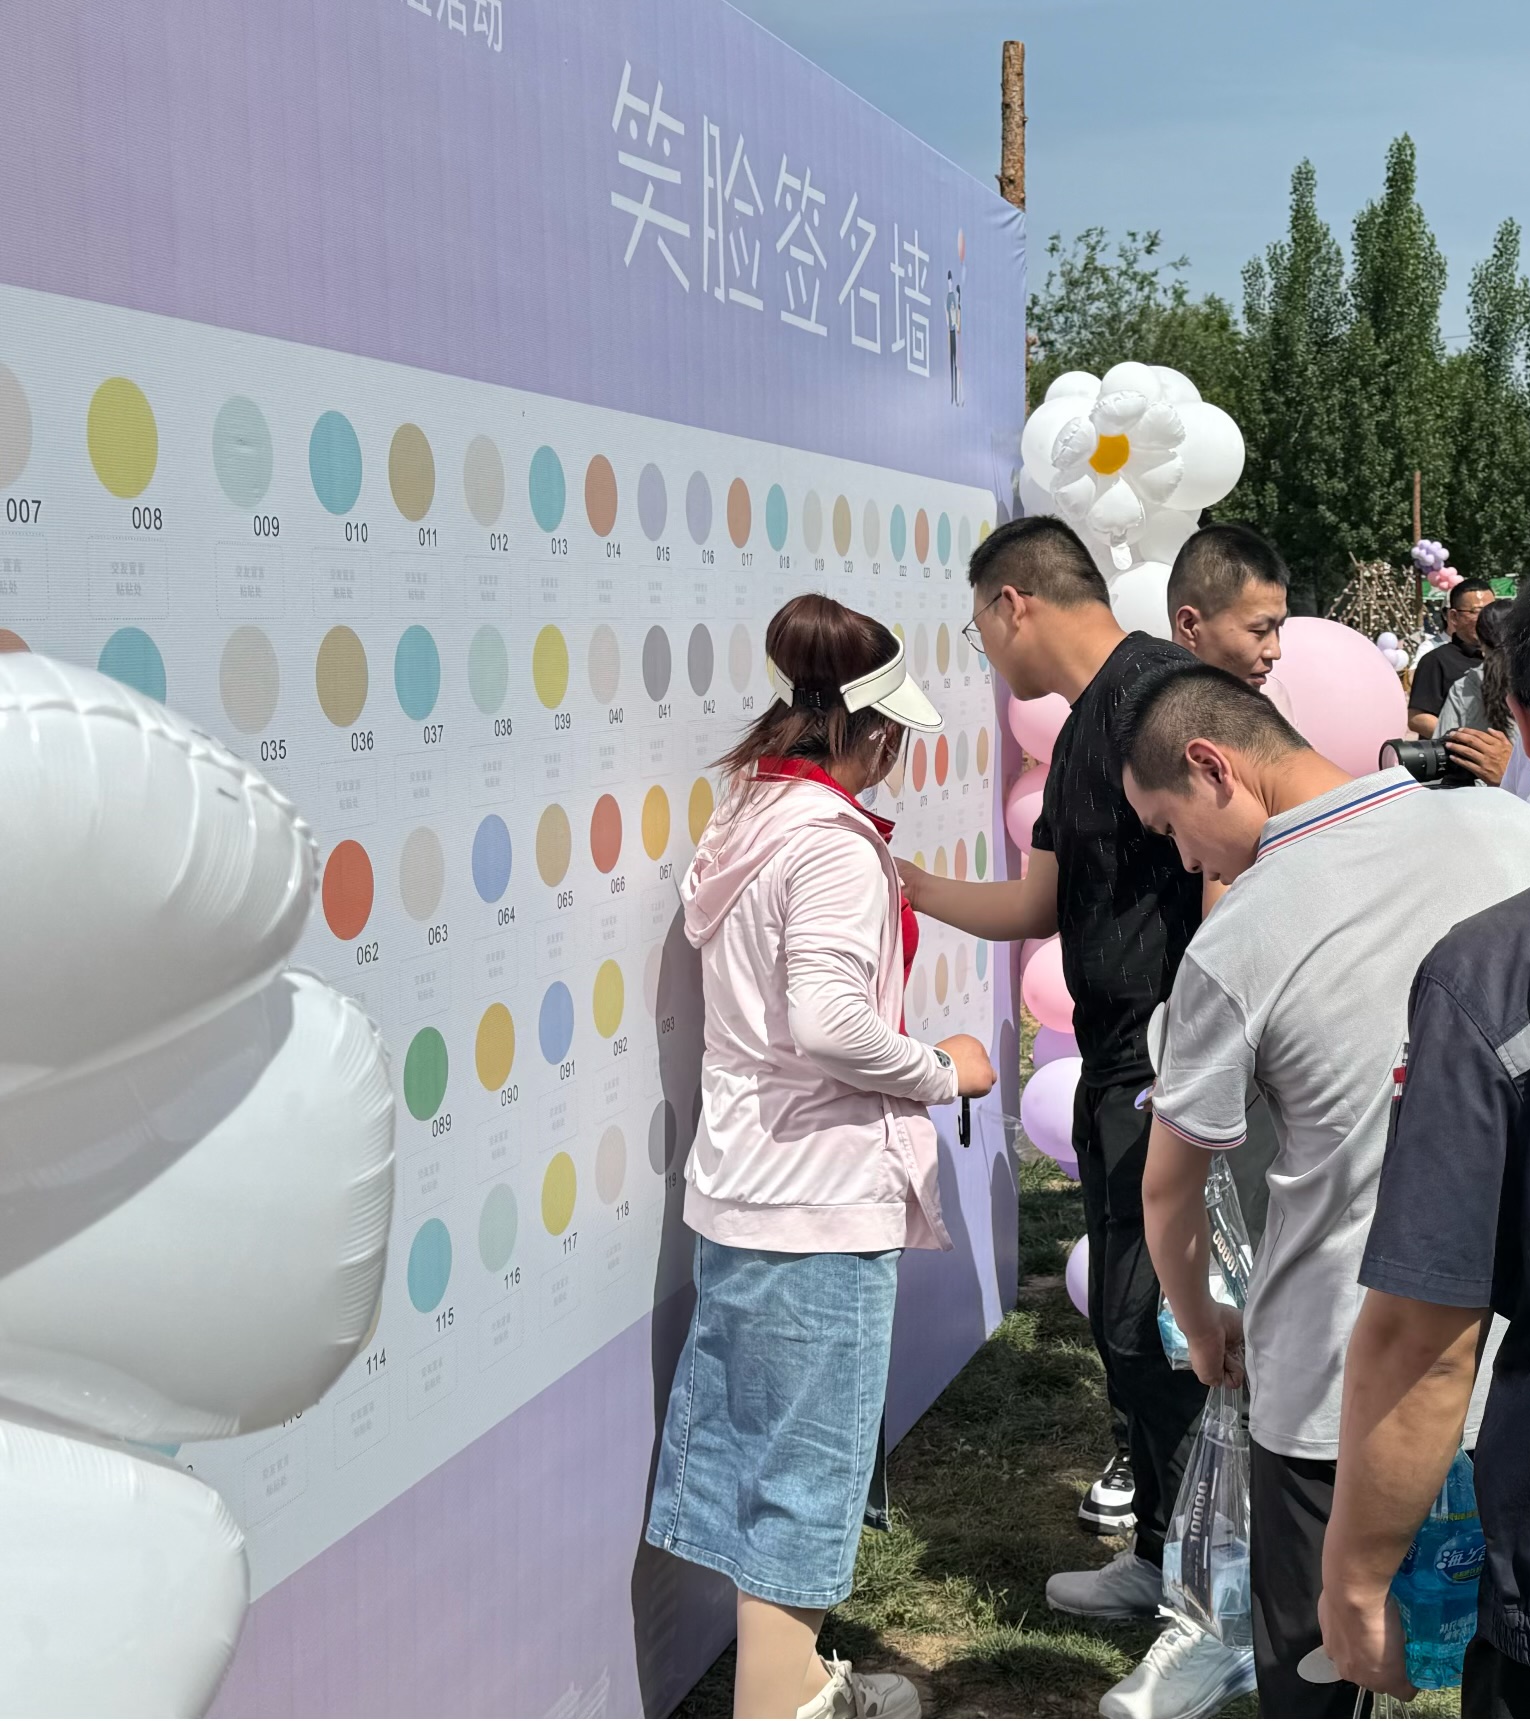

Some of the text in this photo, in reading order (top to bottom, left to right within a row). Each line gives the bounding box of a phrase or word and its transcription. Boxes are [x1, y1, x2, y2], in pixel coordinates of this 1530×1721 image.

[610, 60, 932, 379] 笑脸签名墙
[6, 498, 42, 524] 007
[132, 506, 163, 530] 008
[253, 515, 280, 537] 009
[345, 522, 368, 543] 010
[418, 527, 437, 547] 011
[490, 533, 509, 551] 012
[551, 538, 568, 555] 013
[606, 542, 621, 558] 014
[656, 546, 670, 561] 015
[702, 549, 715, 564] 016
[741, 553, 753, 566] 017
[779, 555, 790, 569] 018
[814, 558, 825, 571] 019
[844, 560, 853, 573] 020
[872, 562, 881, 574] 021
[658, 704, 671, 719] 041
[703, 700, 716, 715] 042
[742, 696, 754, 710] 043
[554, 712, 571, 731] 039
[609, 708, 624, 724] 040
[423, 725, 444, 745] 037
[494, 718, 513, 737] 038
[260, 739, 287, 761] 035
[351, 731, 374, 752] 036
[659, 863, 673, 881] 067
[610, 875, 626, 894] 066
[556, 890, 574, 910] 065
[498, 906, 515, 926] 064
[427, 924, 449, 946] 063
[356, 942, 380, 966] 062
[661, 1016, 676, 1034] 093
[612, 1037, 628, 1057] 092
[559, 1059, 576, 1081] 091
[500, 1084, 519, 1108] 090
[431, 1114, 453, 1139] 089
[615, 1201, 630, 1221] 118
[562, 1232, 578, 1255] 117
[504, 1267, 521, 1290] 116
[435, 1306, 455, 1333] 115
[366, 1347, 387, 1375] 114
[1189, 1481, 1208, 1544] 10000
